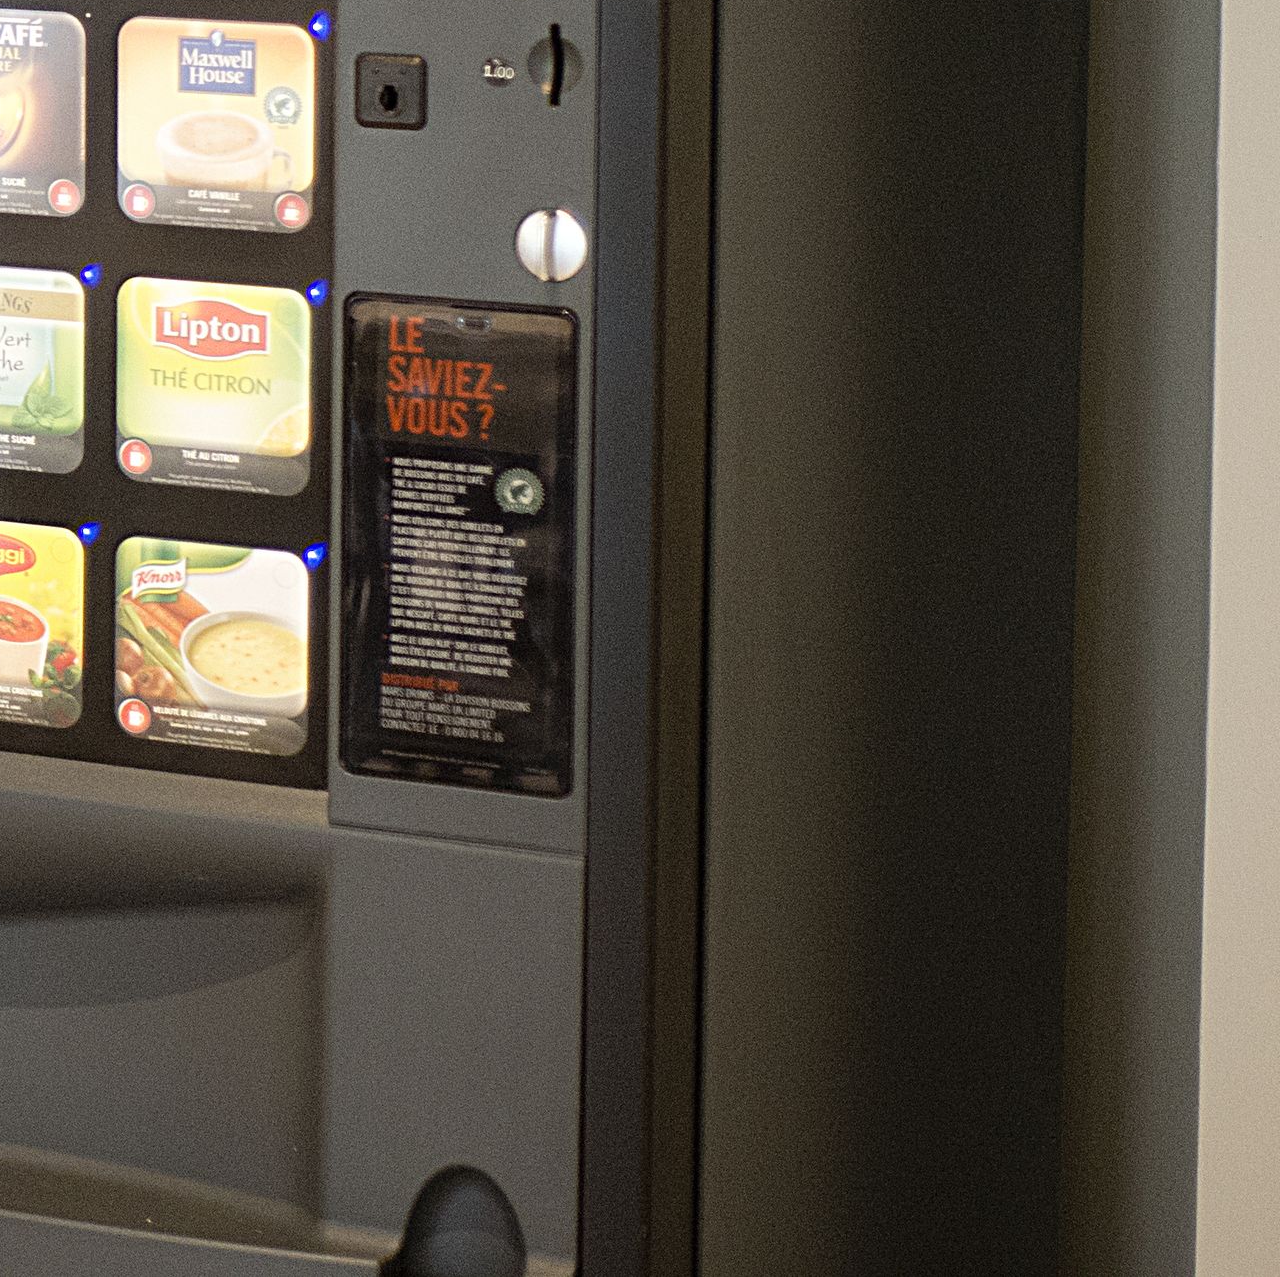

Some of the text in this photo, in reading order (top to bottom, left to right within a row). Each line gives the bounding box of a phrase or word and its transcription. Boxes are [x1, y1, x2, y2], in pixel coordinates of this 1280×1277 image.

[182, 48, 253, 69] Maxwell
[189, 67, 245, 85] House
[163, 311, 260, 346] Lipton
[389, 315, 425, 353] LE
[150, 368, 271, 396] THÉ CITRON
[388, 354, 508, 400] SAVIEZ-
[385, 395, 494, 441] VOUS ?
[11, 434, 36, 445] SUCRÉ
[212, 452, 240, 463] CITRON
[136, 570, 182, 586] Knorr
